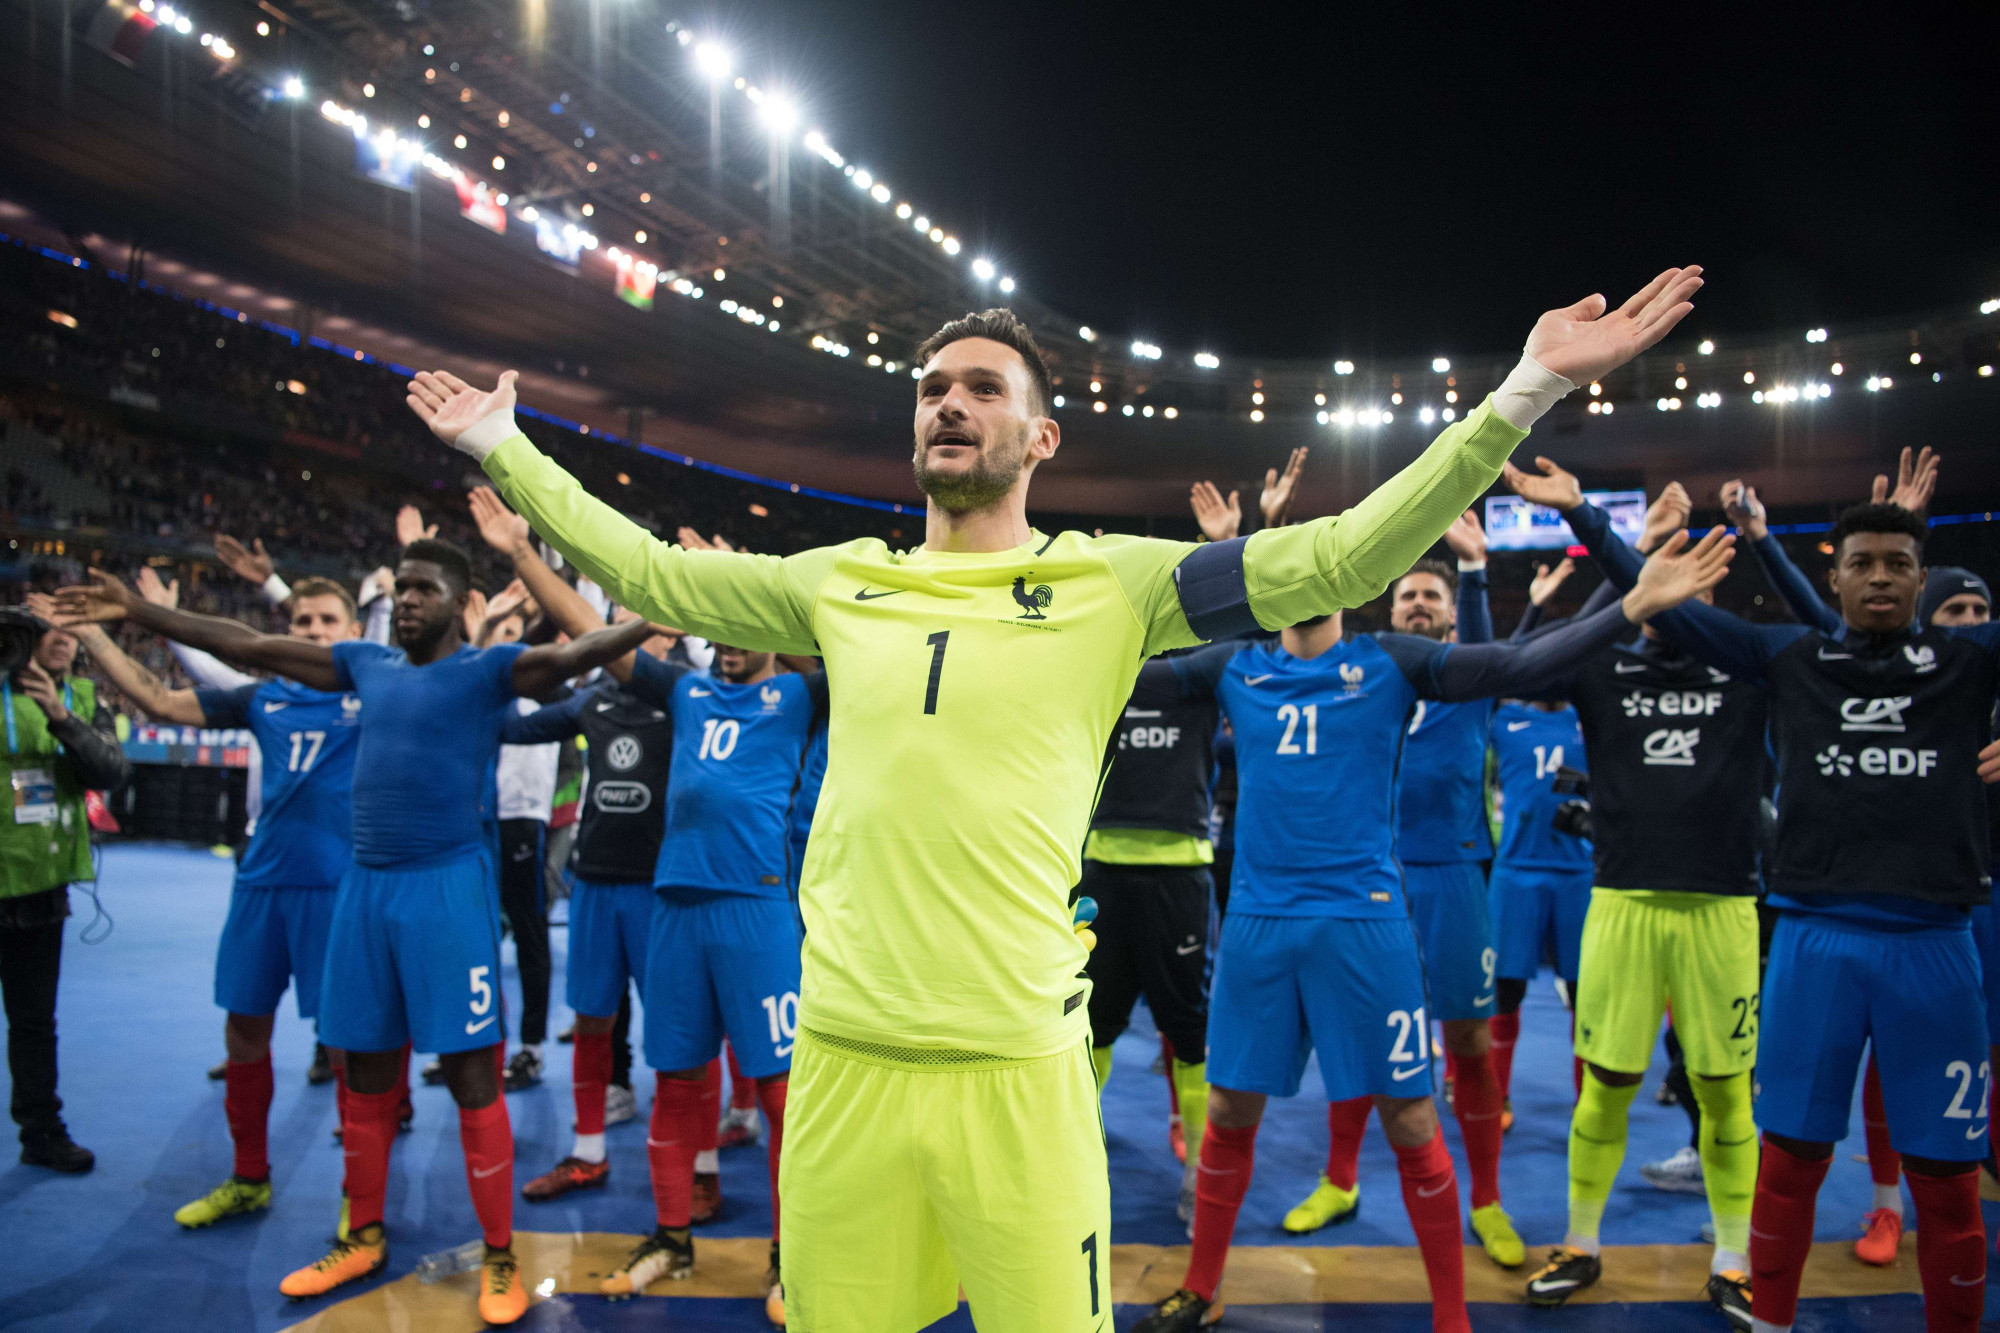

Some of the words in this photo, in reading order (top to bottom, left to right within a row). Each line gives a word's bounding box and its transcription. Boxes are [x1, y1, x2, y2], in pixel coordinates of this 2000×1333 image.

[924, 630, 950, 715] 1
[288, 731, 326, 772] 17
[698, 718, 740, 761] 10
[1276, 703, 1318, 755] 21
[1533, 744, 1564, 779] 14
[469, 965, 491, 1016] 5
[1481, 946, 1497, 989] 9
[762, 991, 800, 1042] 10
[1387, 1007, 1427, 1062] 21
[1081, 1231, 1099, 1317] 1
